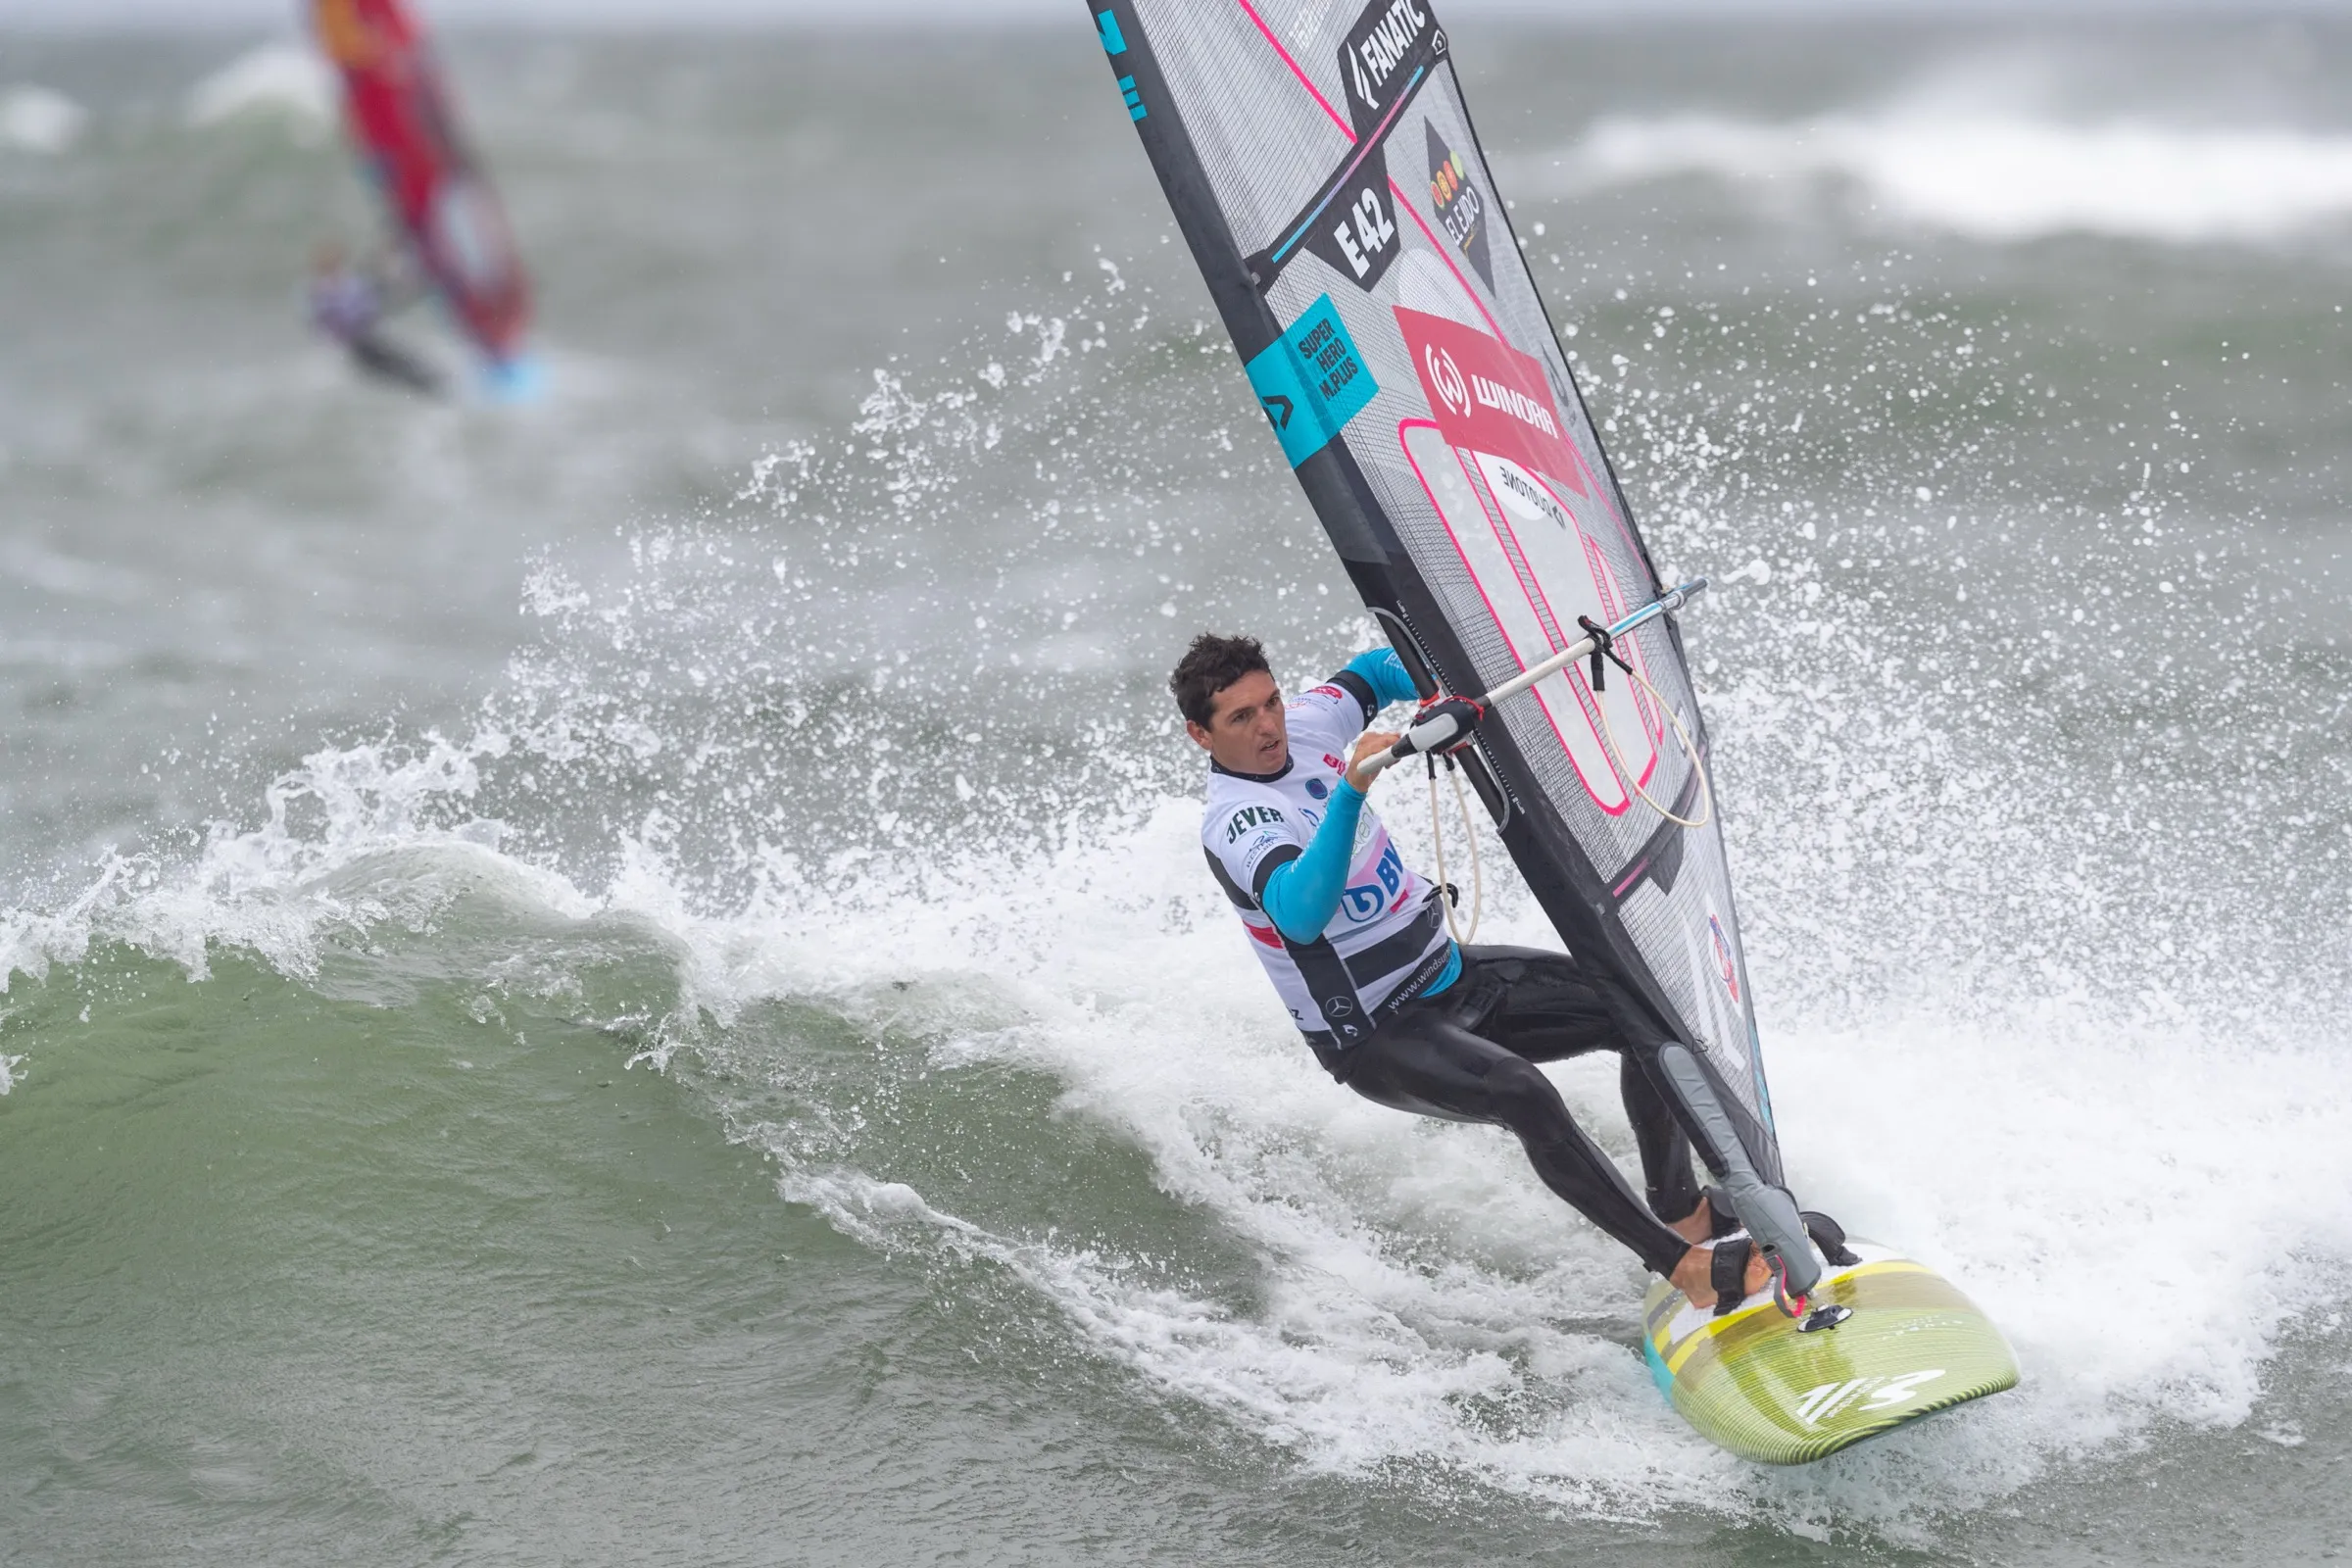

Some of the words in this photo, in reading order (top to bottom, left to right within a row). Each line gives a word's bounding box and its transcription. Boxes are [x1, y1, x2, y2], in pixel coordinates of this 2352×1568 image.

[1360, 0, 1425, 87] FANATIC
[1334, 188, 1395, 279] E42
[1298, 318, 1336, 359] SUPER
[1316, 337, 1347, 372] HERO
[1319, 356, 1357, 401] M.PLUS
[1471, 373, 1559, 439] WINORA
[1226, 806, 1285, 844] JEVER
